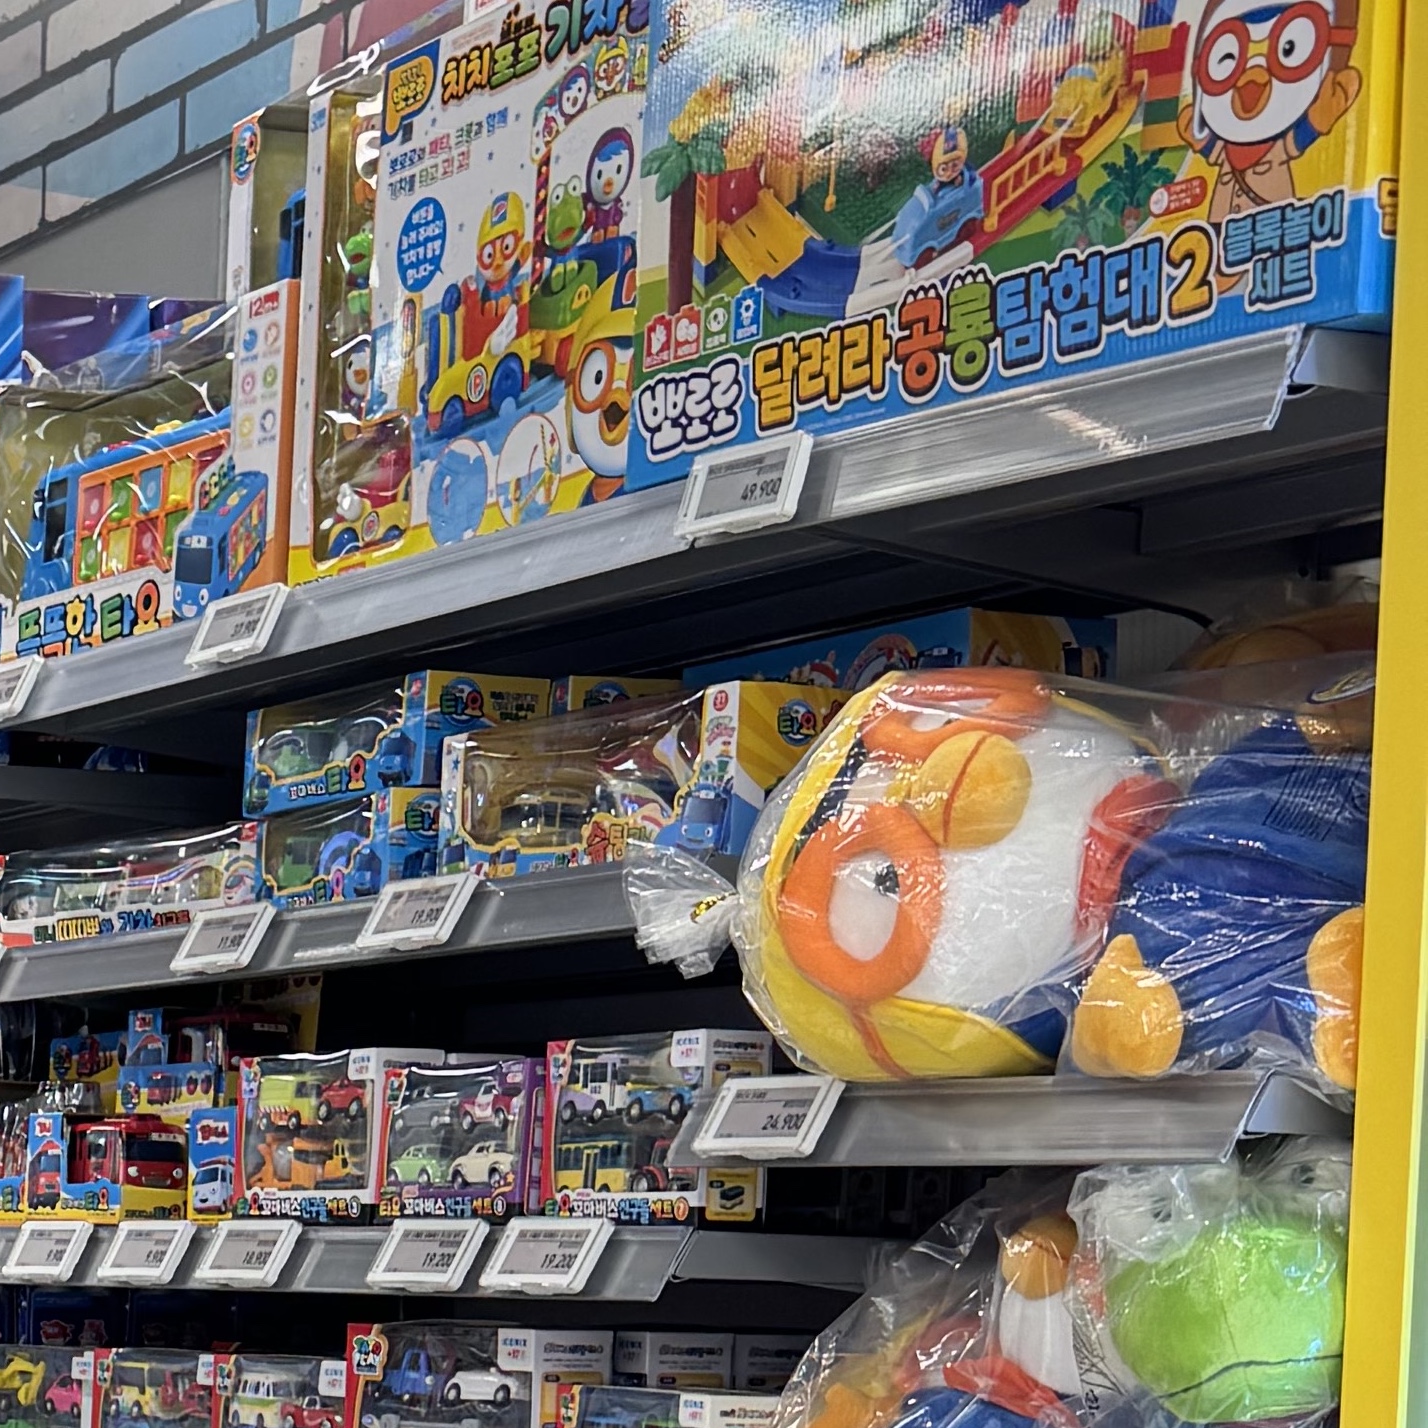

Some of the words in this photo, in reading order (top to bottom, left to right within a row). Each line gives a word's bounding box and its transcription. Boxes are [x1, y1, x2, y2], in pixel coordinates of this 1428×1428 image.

[441, 27, 542, 104] 치치포포
[1222, 193, 1345, 268] 블록놀이
[1246, 253, 1315, 308] 세트
[639, 358, 744, 462] 뽀로로
[752, 316, 892, 430] 달려라
[894, 240, 1162, 396] 공룡탐험대
[1167, 224, 1216, 317] 2
[99, 579, 162, 643] 타요
